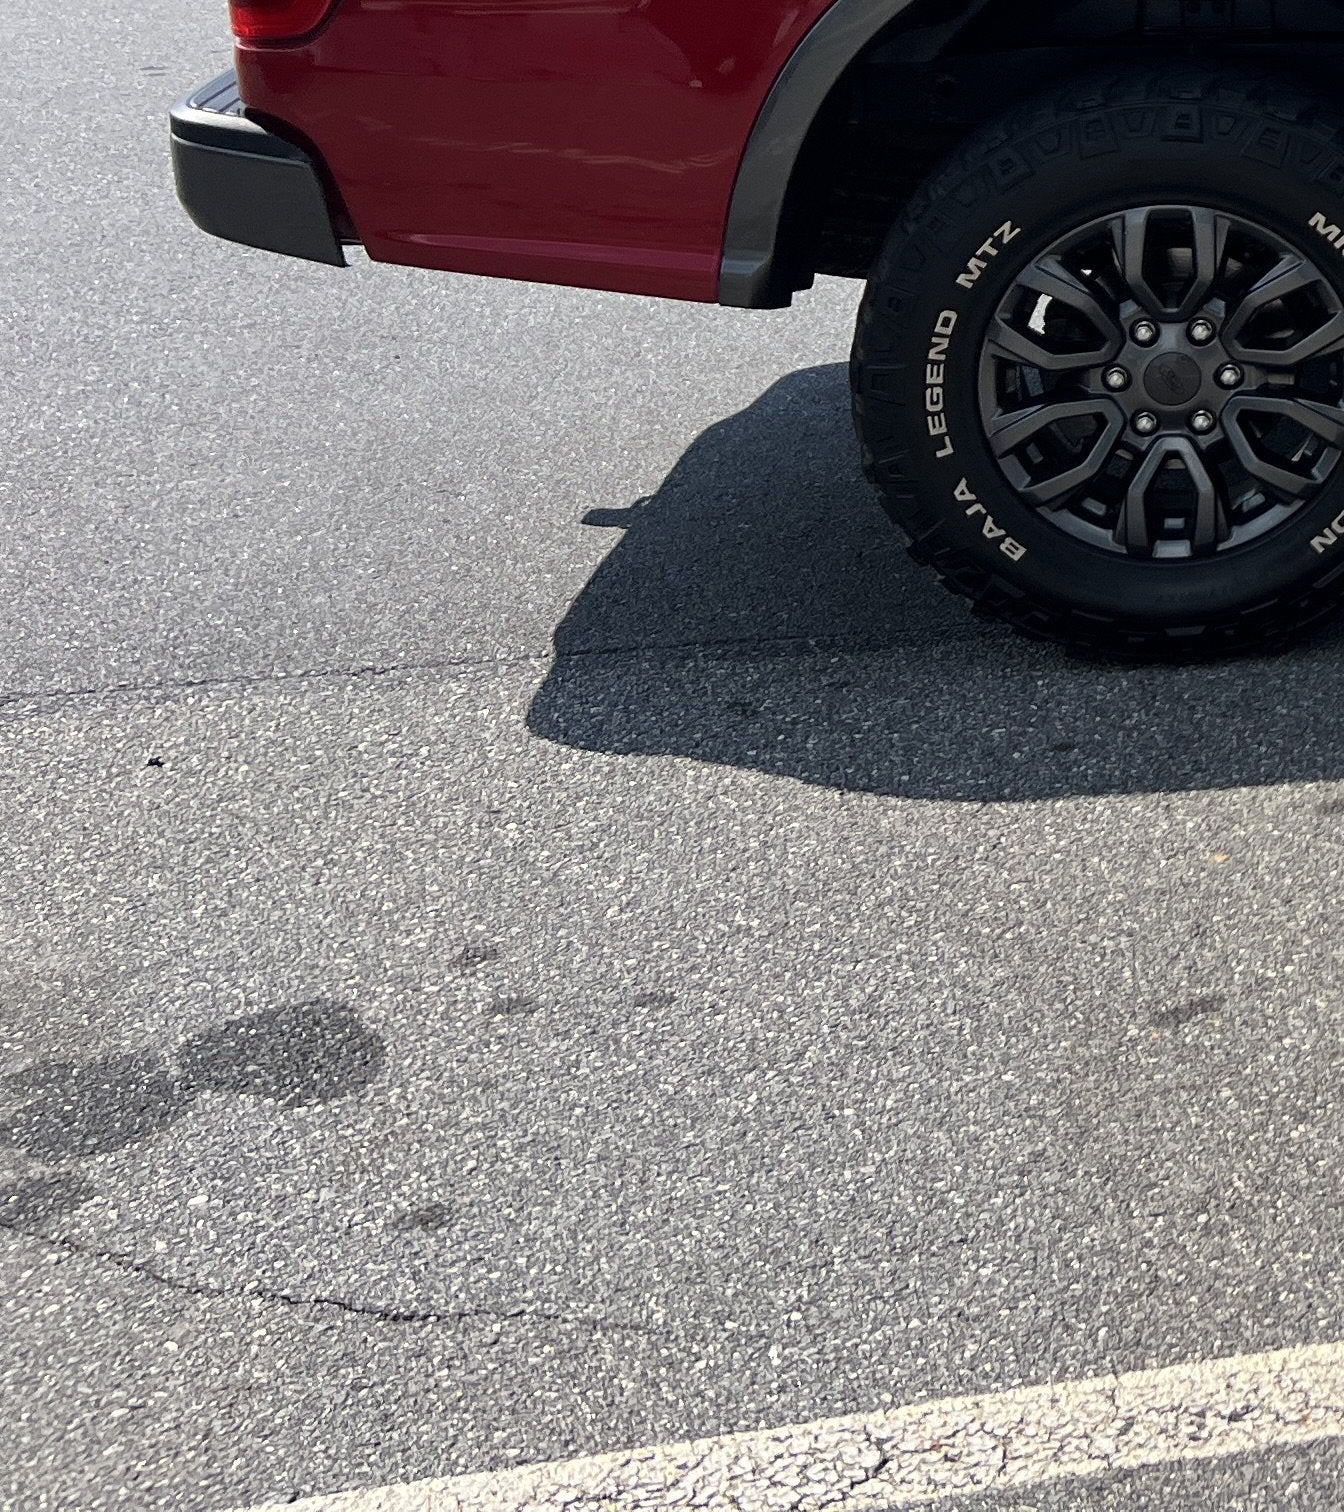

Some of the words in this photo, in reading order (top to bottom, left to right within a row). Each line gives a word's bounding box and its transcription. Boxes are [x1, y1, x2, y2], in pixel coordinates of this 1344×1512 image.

[955, 220, 1021, 289] MTZ
[925, 309, 958, 458] LEGEND
[953, 477, 1027, 561] BAJA
